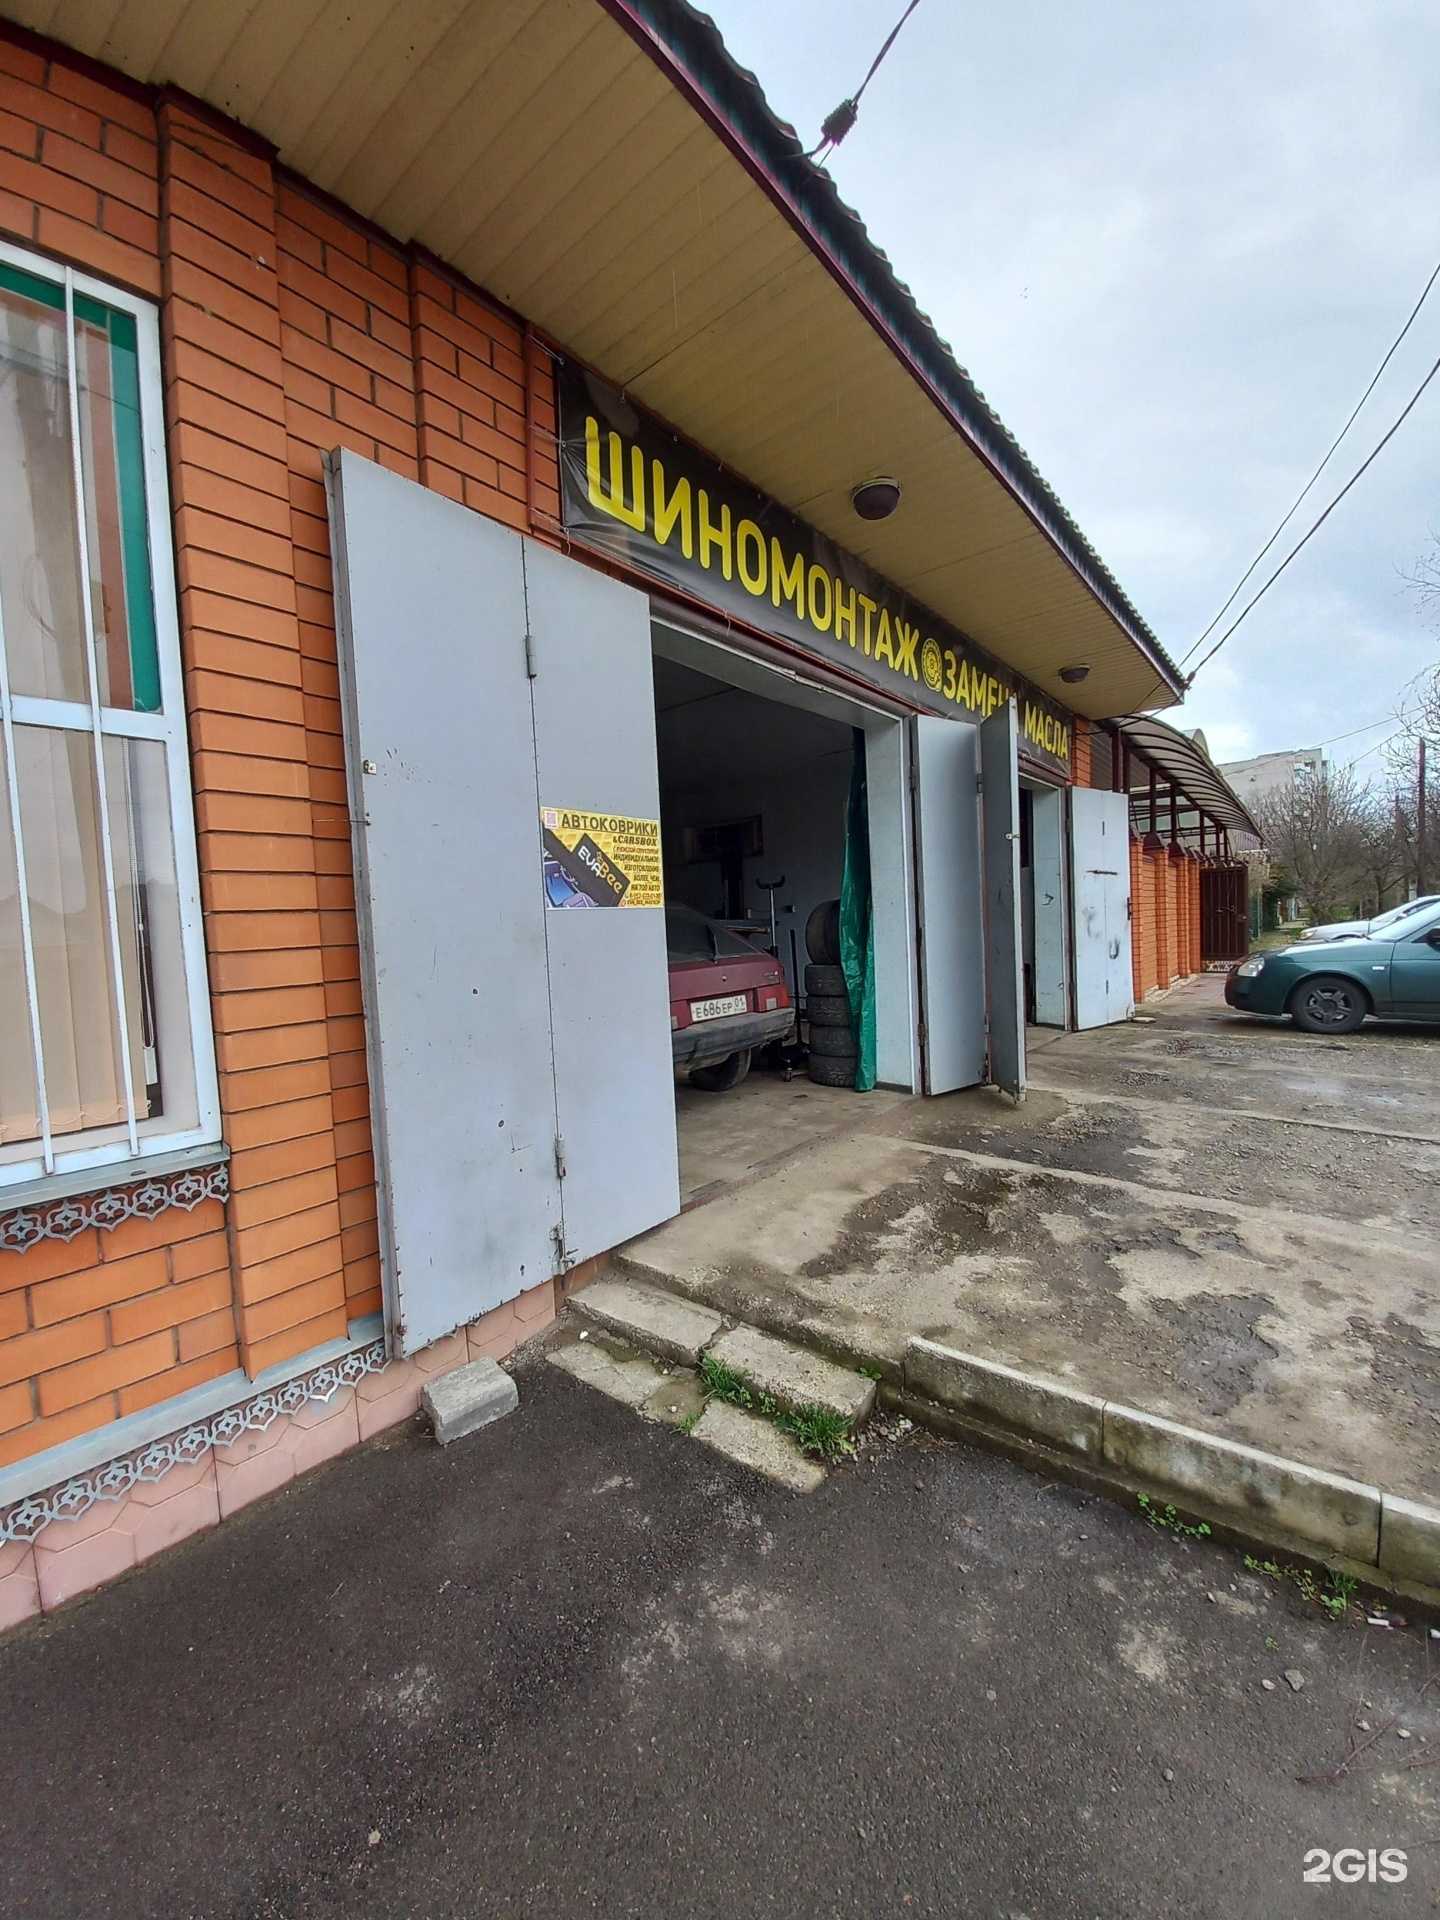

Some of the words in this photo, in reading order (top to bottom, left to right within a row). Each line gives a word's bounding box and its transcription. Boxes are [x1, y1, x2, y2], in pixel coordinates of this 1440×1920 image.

[585, 416, 920, 682] ШИНОМОНТАЖ
[943, 650, 1019, 734] ЗАМЕ
[1023, 700, 1068, 760] МАСЛА
[562, 813, 657, 836] АВТОКОВРИКИ
[578, 846, 601, 877] EVA
[695, 1001, 733, 1018] Е686ЕР
